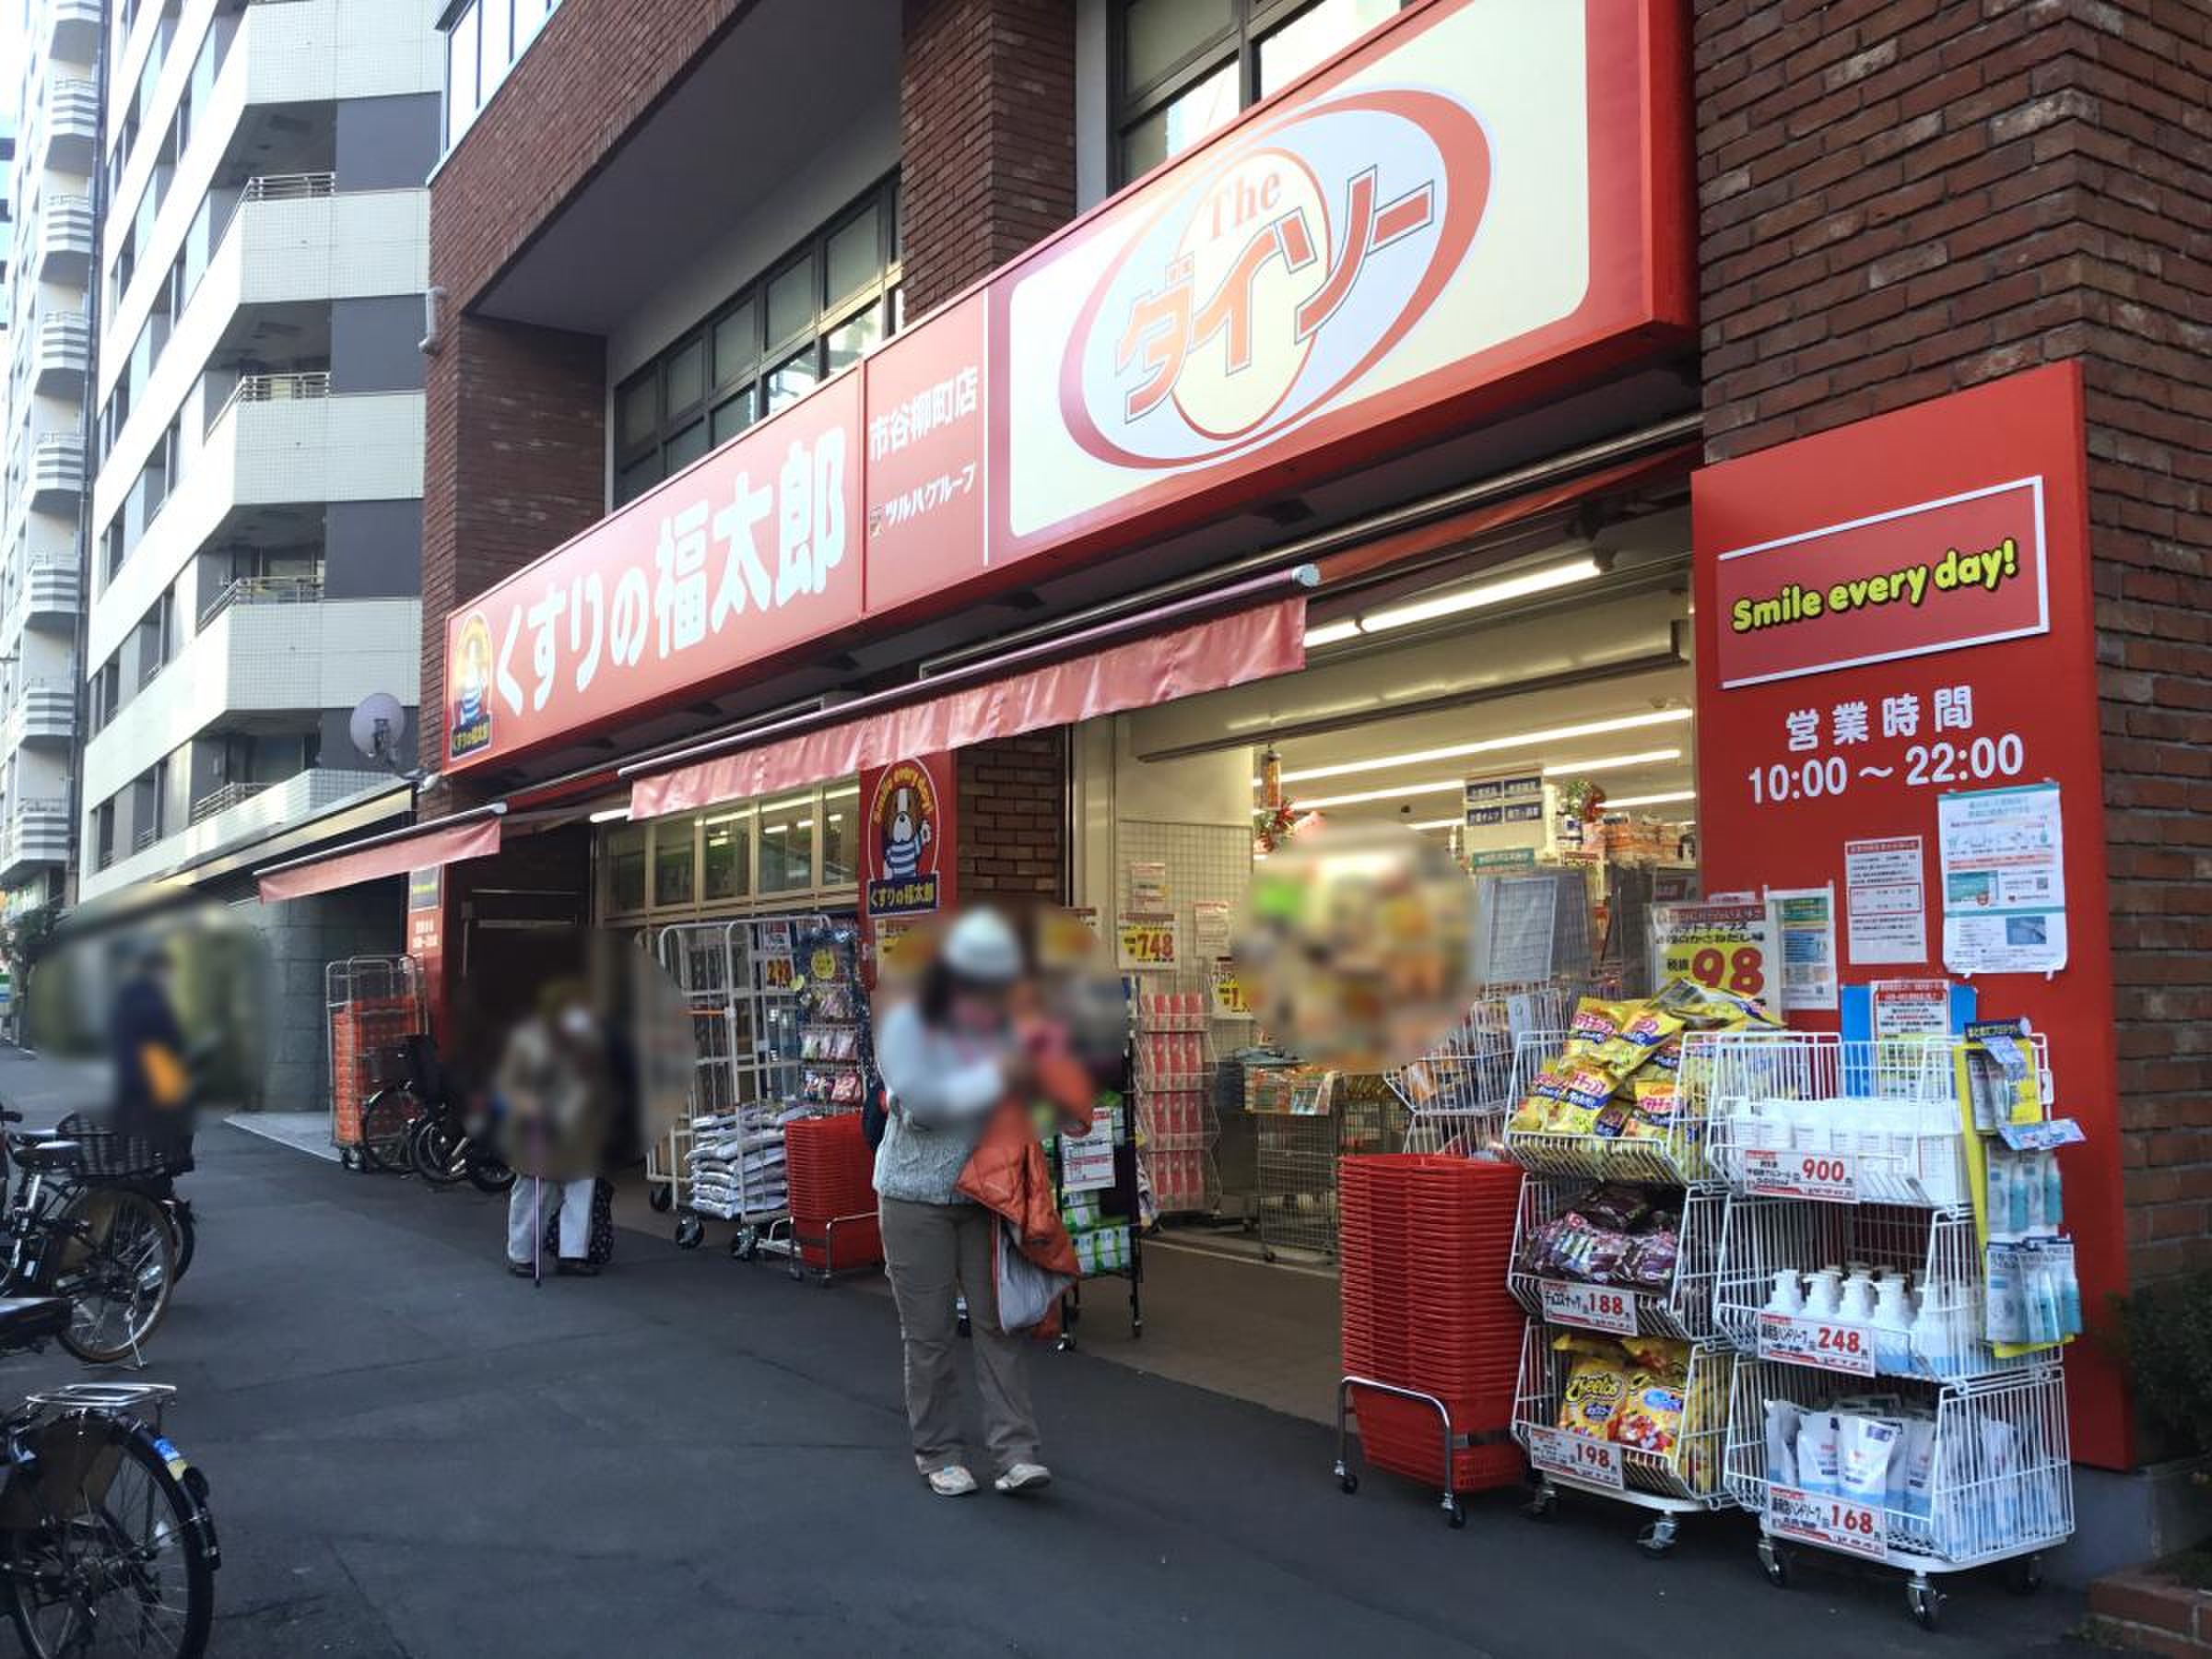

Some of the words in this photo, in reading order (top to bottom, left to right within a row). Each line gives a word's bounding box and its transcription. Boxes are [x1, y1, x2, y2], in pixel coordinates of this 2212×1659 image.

[1206, 170, 1282, 241] The
[1114, 164, 1435, 424] ダイソー
[868, 368, 978, 460] 市谷柳町店
[497, 427, 846, 715] くすりの福太郎
[1732, 584, 1823, 632] Smile
[1828, 564, 1927, 606] every
[1934, 538, 2019, 590] day!
[1785, 685, 1973, 752] 営業時間
[1748, 757, 1848, 805] 10:00
[1905, 734, 2024, 786] 22:00
[1136, 934, 1173, 958] 748
[1692, 947, 1765, 996] 98
[1803, 1159, 1844, 1182] 900
[1590, 1293, 1623, 1315] 188
[1818, 1327, 1860, 1353] 248
[1576, 1442, 1609, 1467] 198
[1831, 1504, 1874, 1535] 168
